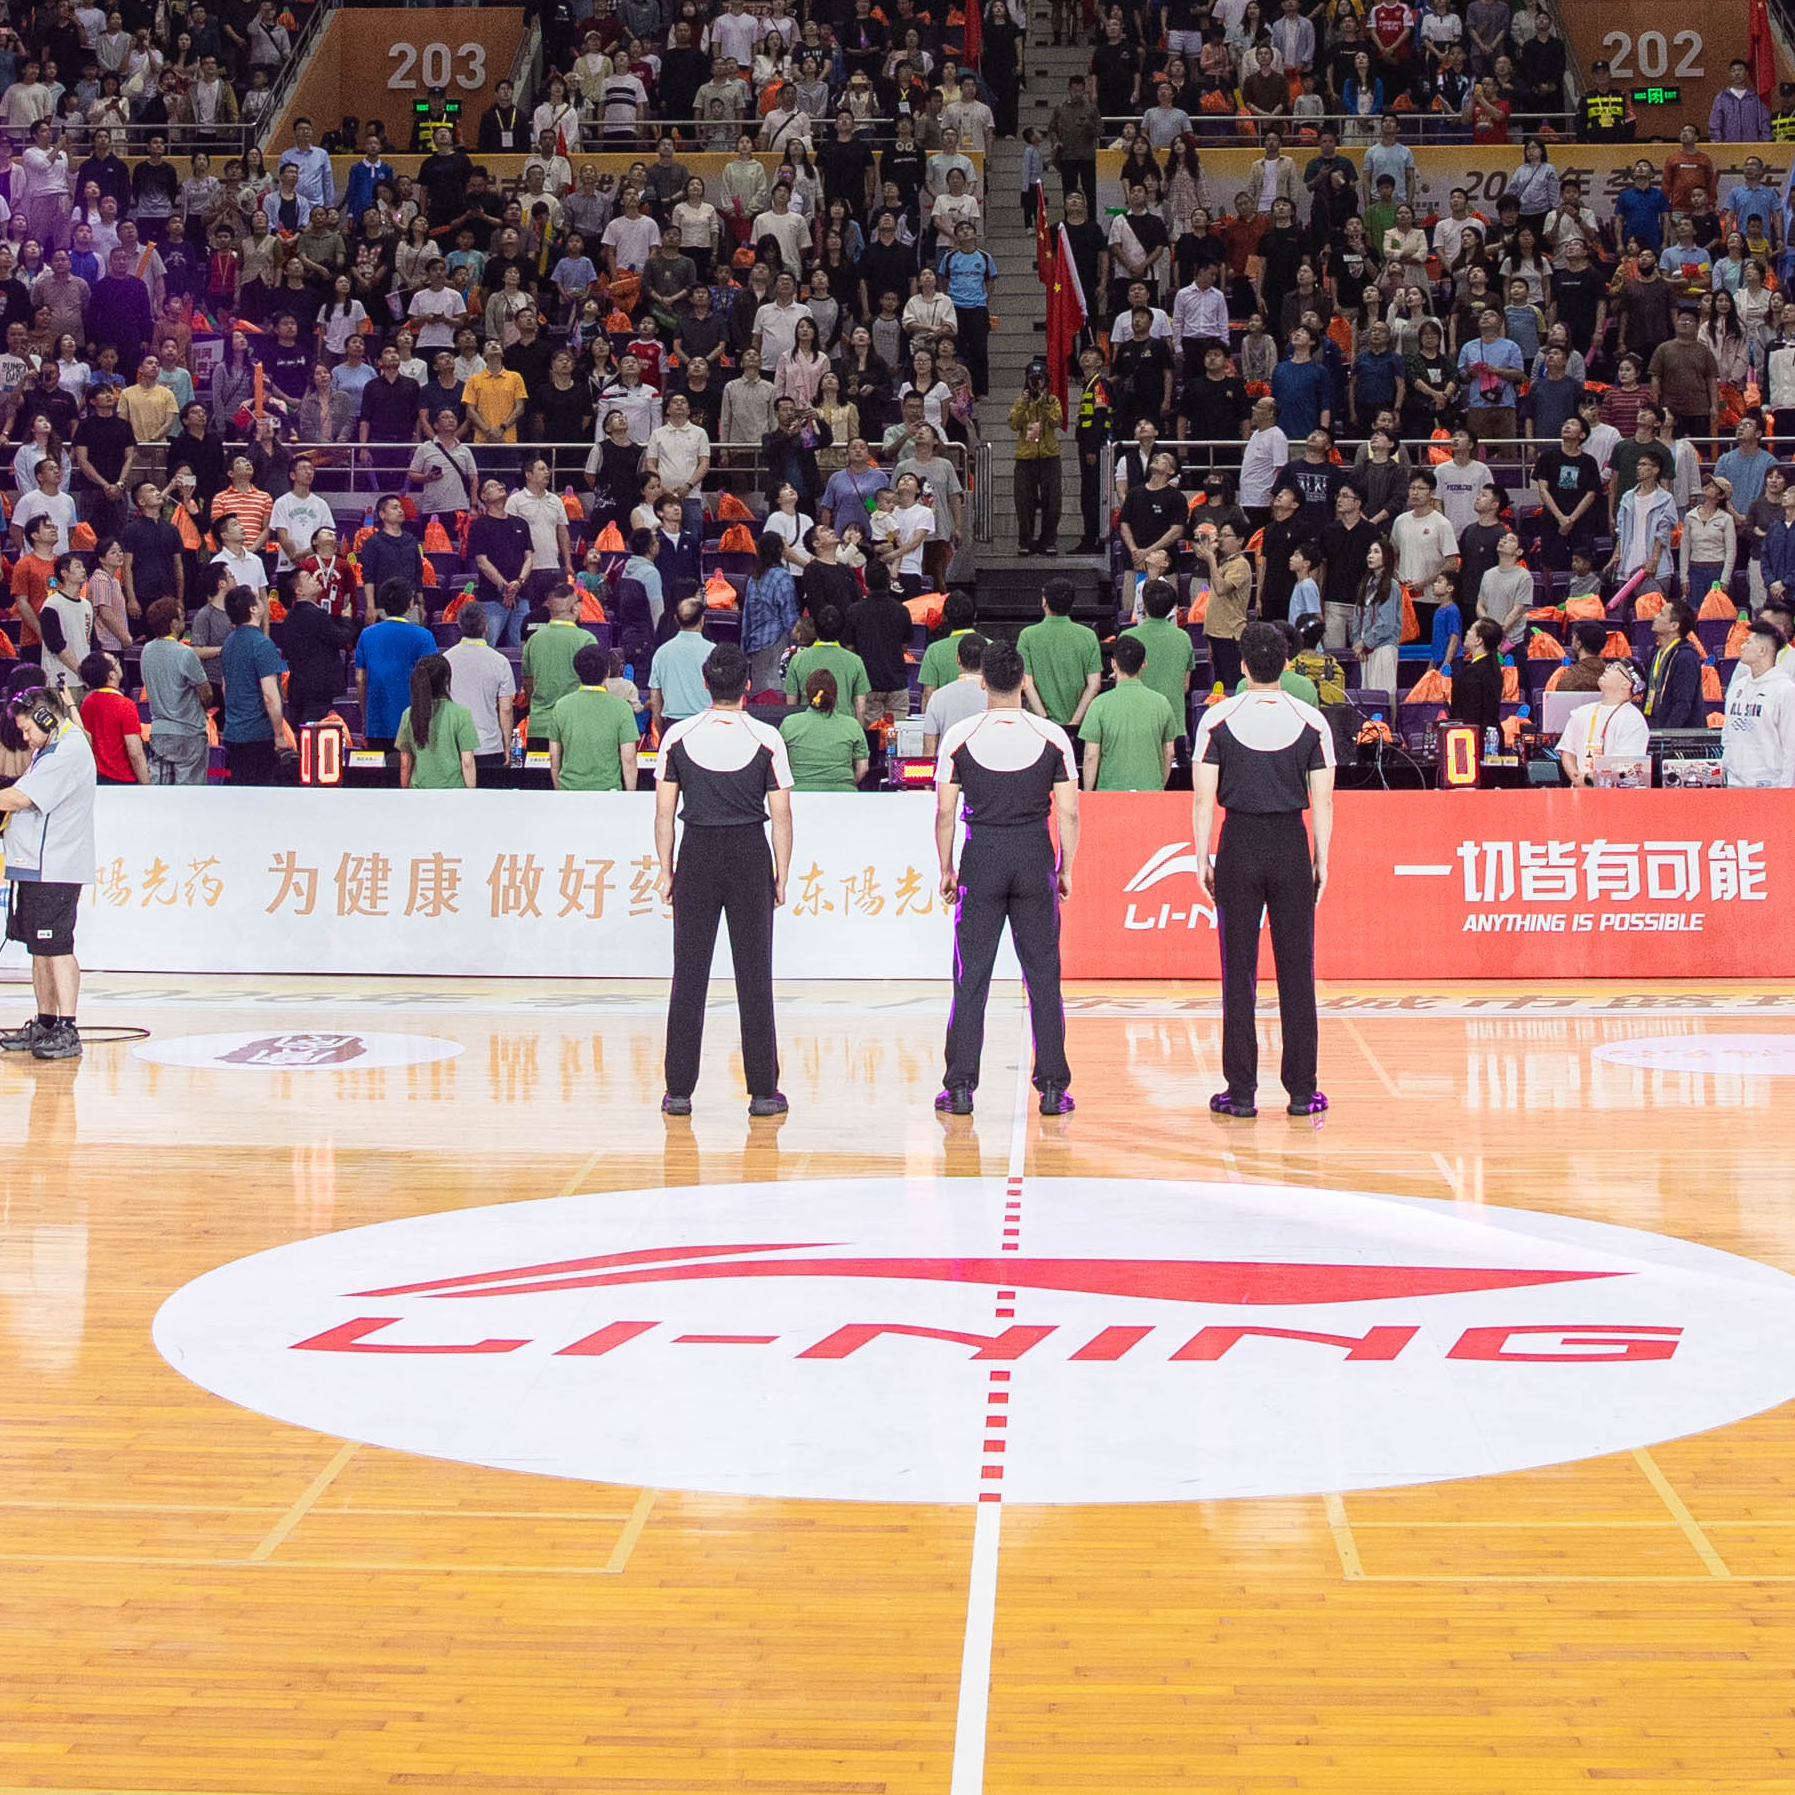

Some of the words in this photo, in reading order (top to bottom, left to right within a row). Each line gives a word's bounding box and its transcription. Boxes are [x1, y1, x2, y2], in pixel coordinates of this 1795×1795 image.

[387, 42, 487, 90] 203
[1603, 30, 1705, 78] 202
[1447, 728, 1476, 784] 0
[265, 851, 462, 918] 为健康
[792, 860, 951, 918] 东陽光
[1393, 838, 1768, 902] 一切皆有可能
[1462, 913, 1566, 932] ANYTHING
[1571, 913, 1594, 932] IS
[1599, 913, 1705, 932] POSSIBLE
[287, 1316, 1685, 1363] LI-NING
